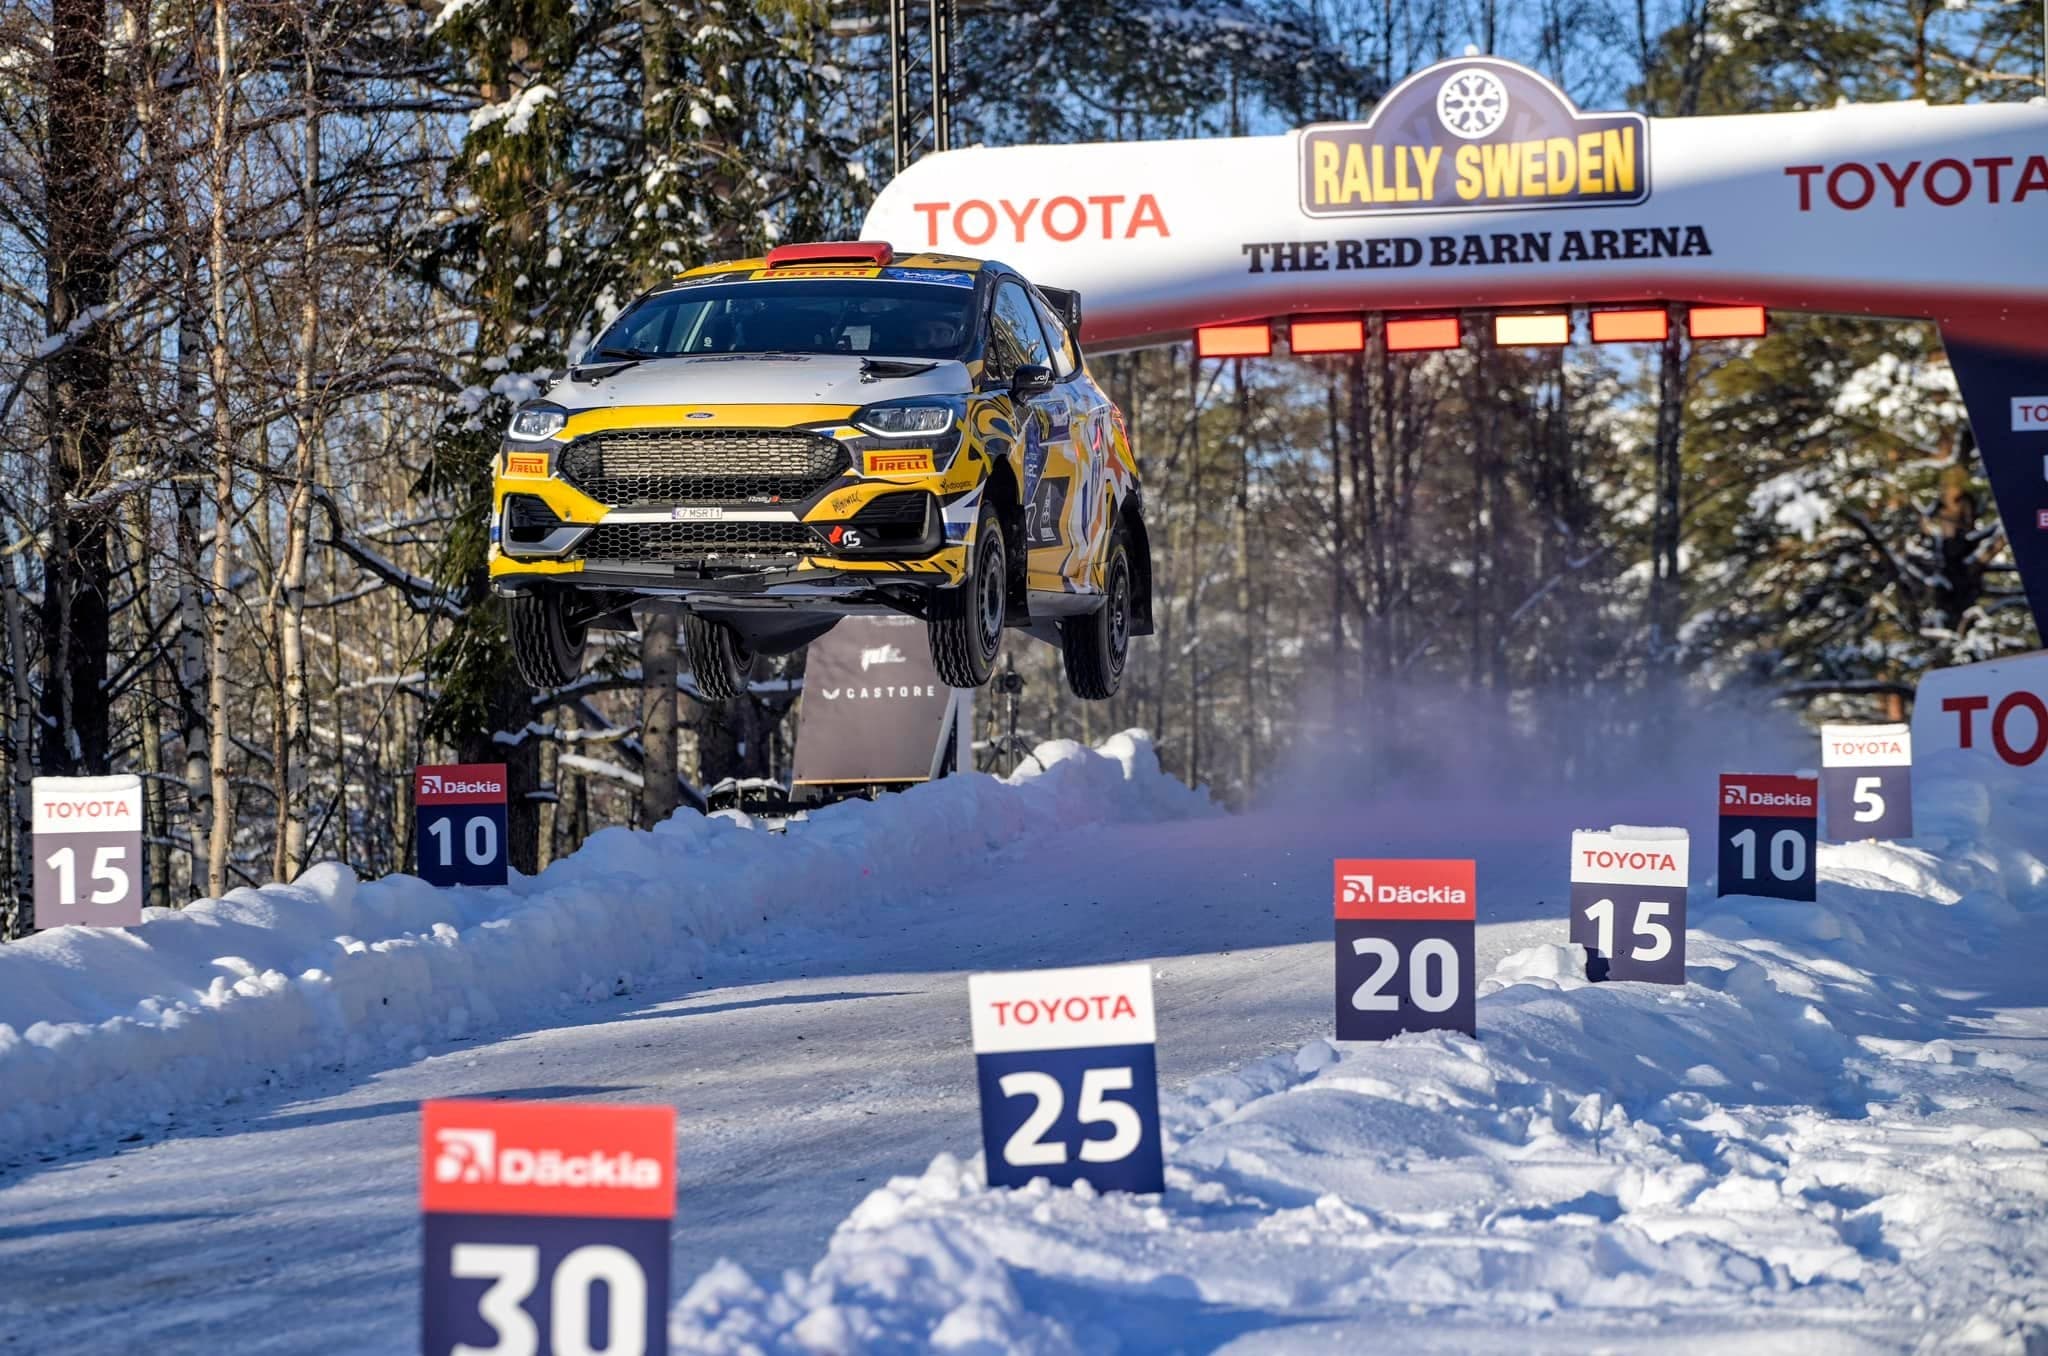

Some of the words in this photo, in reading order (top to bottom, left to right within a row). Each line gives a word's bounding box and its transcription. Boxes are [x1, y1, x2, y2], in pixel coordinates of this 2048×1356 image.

[1312, 140, 1443, 205] RALLY
[1455, 126, 1635, 200] SWEDEN
[1784, 155, 2048, 212] TOYOTA
[913, 194, 1170, 247] TOYOTA
[1241, 240, 1329, 274] THE
[1334, 236, 1423, 270] RED
[1429, 232, 1552, 267] BARN
[1558, 225, 1713, 262] ARENA
[510, 457, 543, 474] PIRELLI
[870, 454, 928, 472] PIRELLI
[846, 685, 935, 699] CASTORE
[1832, 741, 1902, 755] TOYOTA
[43, 801, 130, 818] TOYOTA
[444, 781, 501, 794] Däckia
[1749, 792, 1812, 807] Däckia
[1853, 776, 1886, 823] 5
[427, 815, 498, 866] 10
[1583, 850, 1676, 872] TOYOTA
[1730, 828, 1806, 881] 10
[46, 847, 129, 905] 15
[1378, 885, 1466, 904] Däckia
[1584, 898, 1673, 962] 15
[1351, 937, 1460, 1013] 20
[990, 994, 1136, 1026] TOYOTA
[998, 1066, 1142, 1167] 25
[450, 1242, 649, 1356] 30
